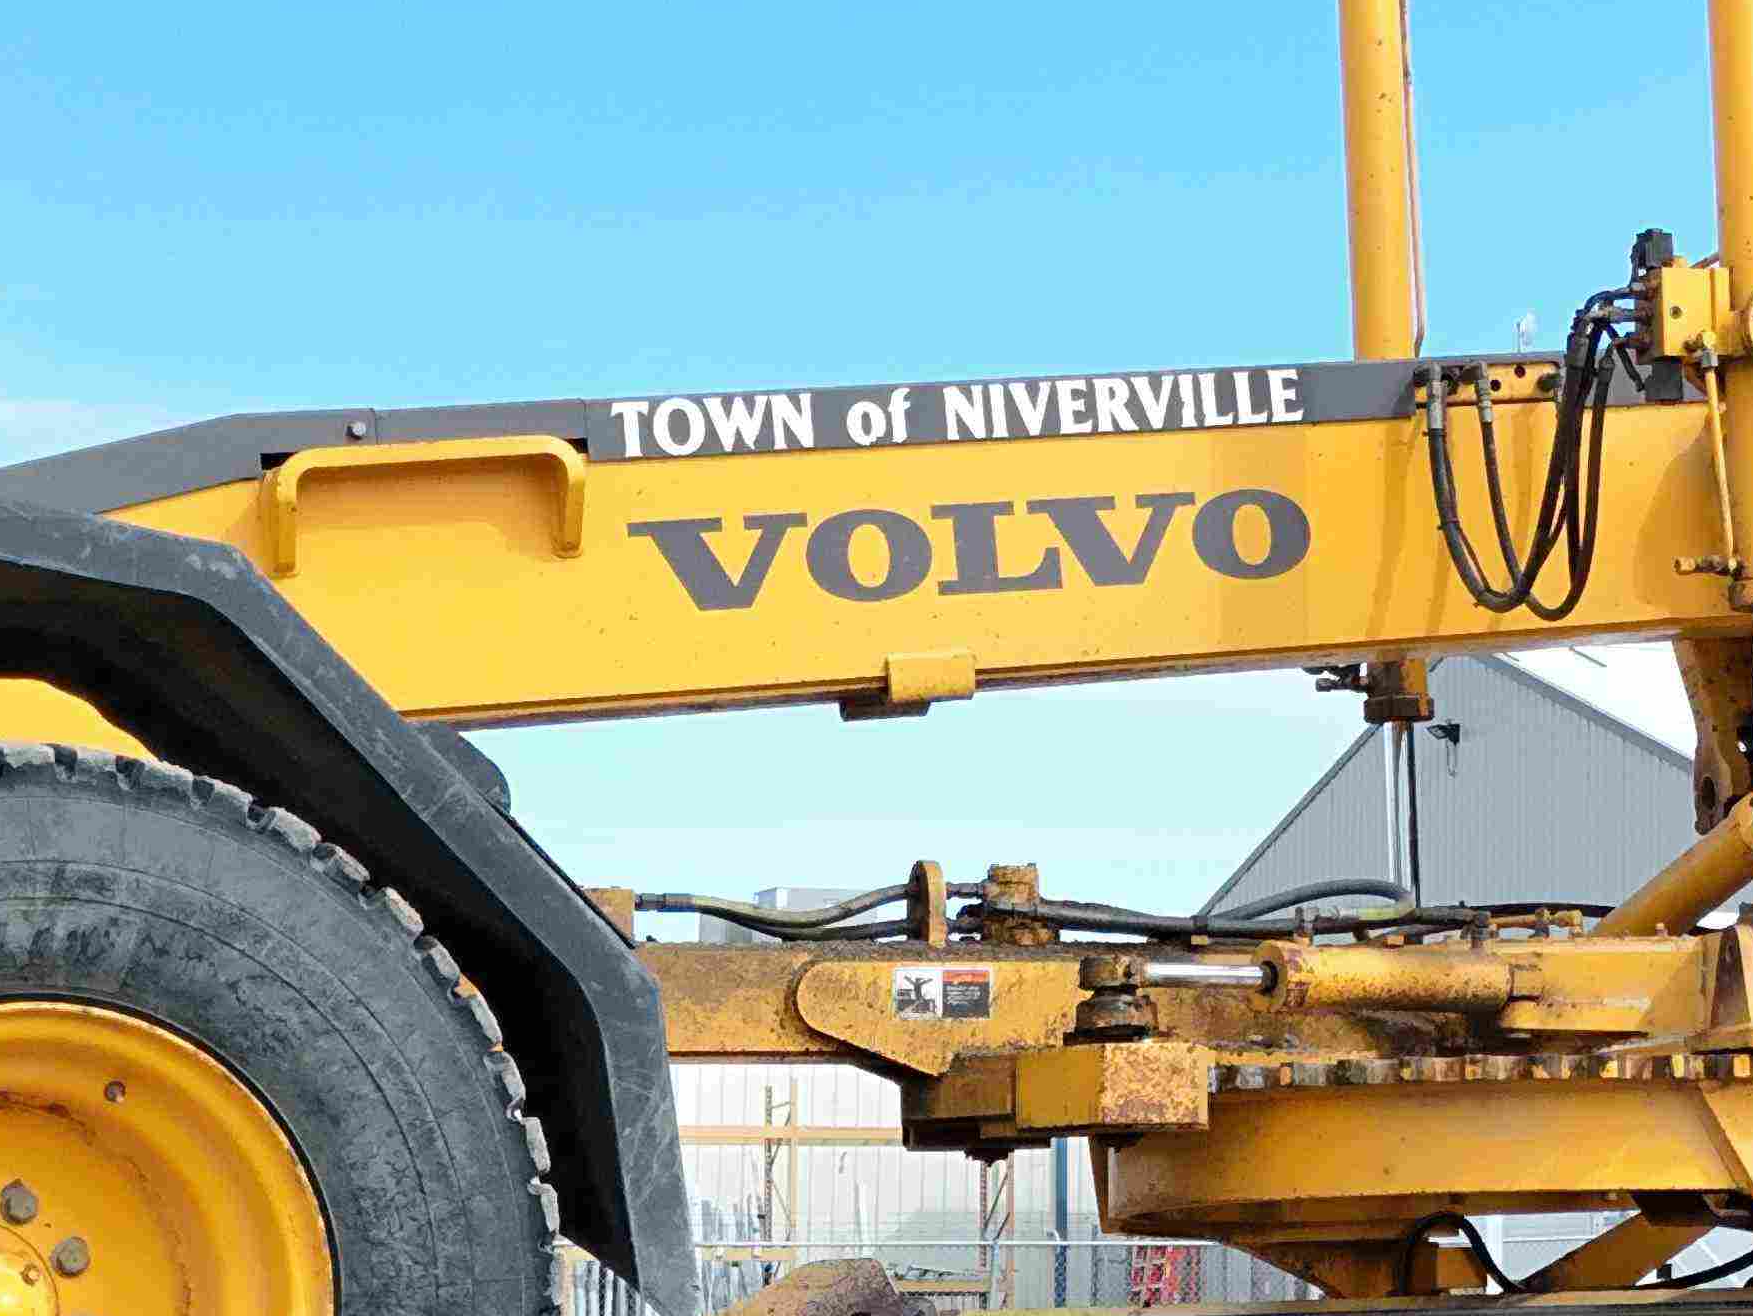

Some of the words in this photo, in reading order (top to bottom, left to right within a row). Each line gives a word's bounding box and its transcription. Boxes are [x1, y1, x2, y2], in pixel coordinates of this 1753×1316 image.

[611, 393, 817, 459] TOWN
[847, 387, 911, 447] of
[945, 369, 1305, 440] NIVERVILLE
[627, 488, 1311, 612] VOLVO
